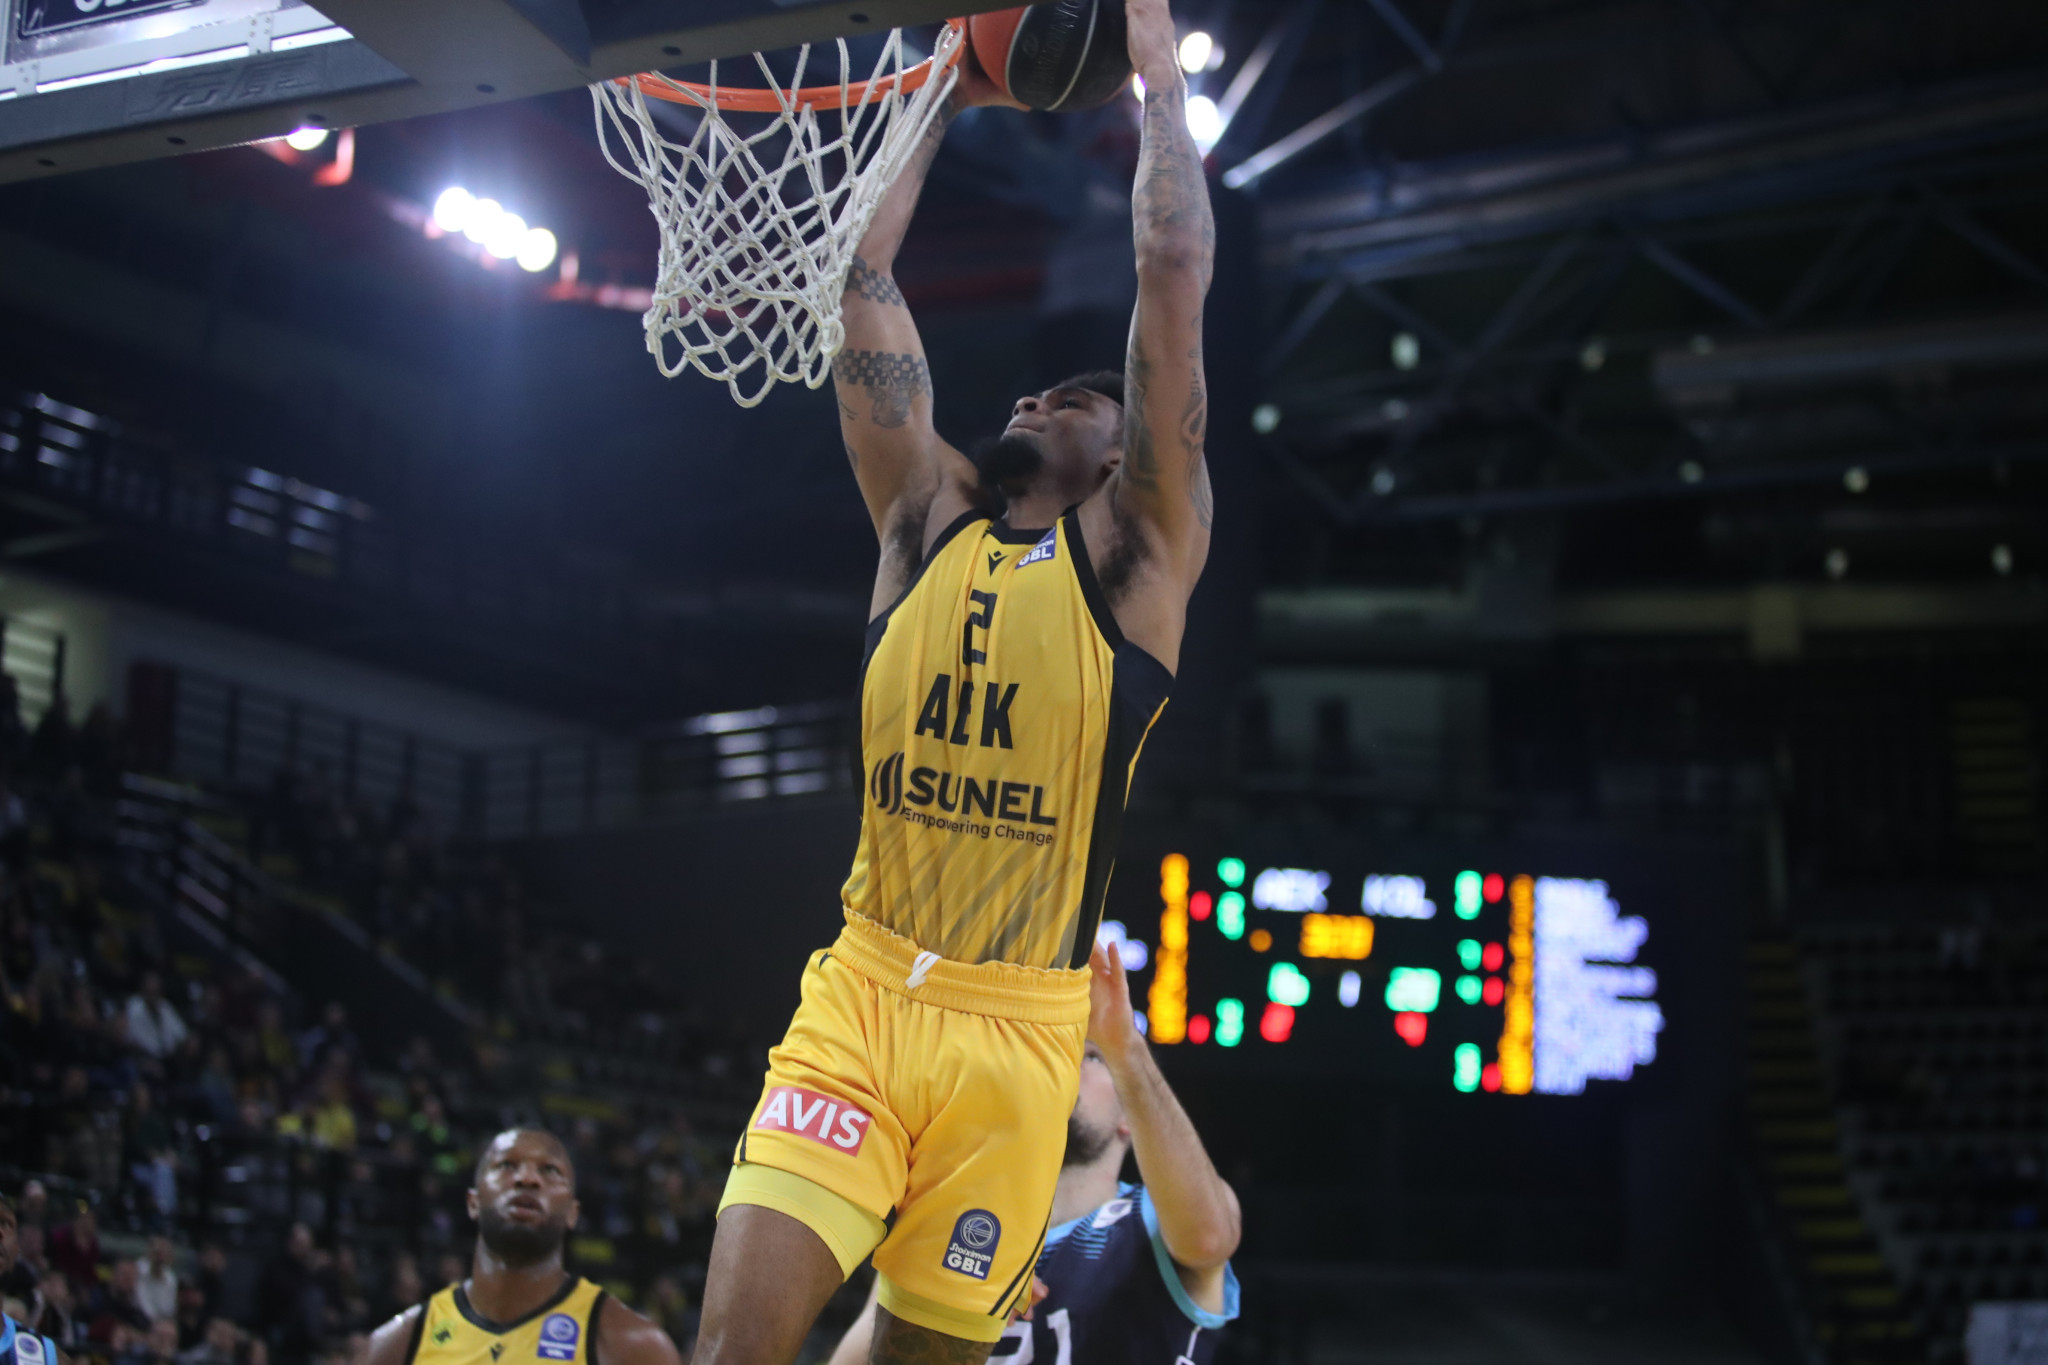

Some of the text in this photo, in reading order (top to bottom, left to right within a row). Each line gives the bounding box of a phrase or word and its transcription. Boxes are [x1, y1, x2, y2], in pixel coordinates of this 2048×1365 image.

[962, 589, 998, 666] 2
[904, 766, 1057, 826] SUNEL
[902, 807, 1053, 847] Empowering Change
[757, 1091, 867, 1149] AVIS
[947, 1252, 985, 1277] GBL
[949, 1242, 992, 1263] Stoiximan
